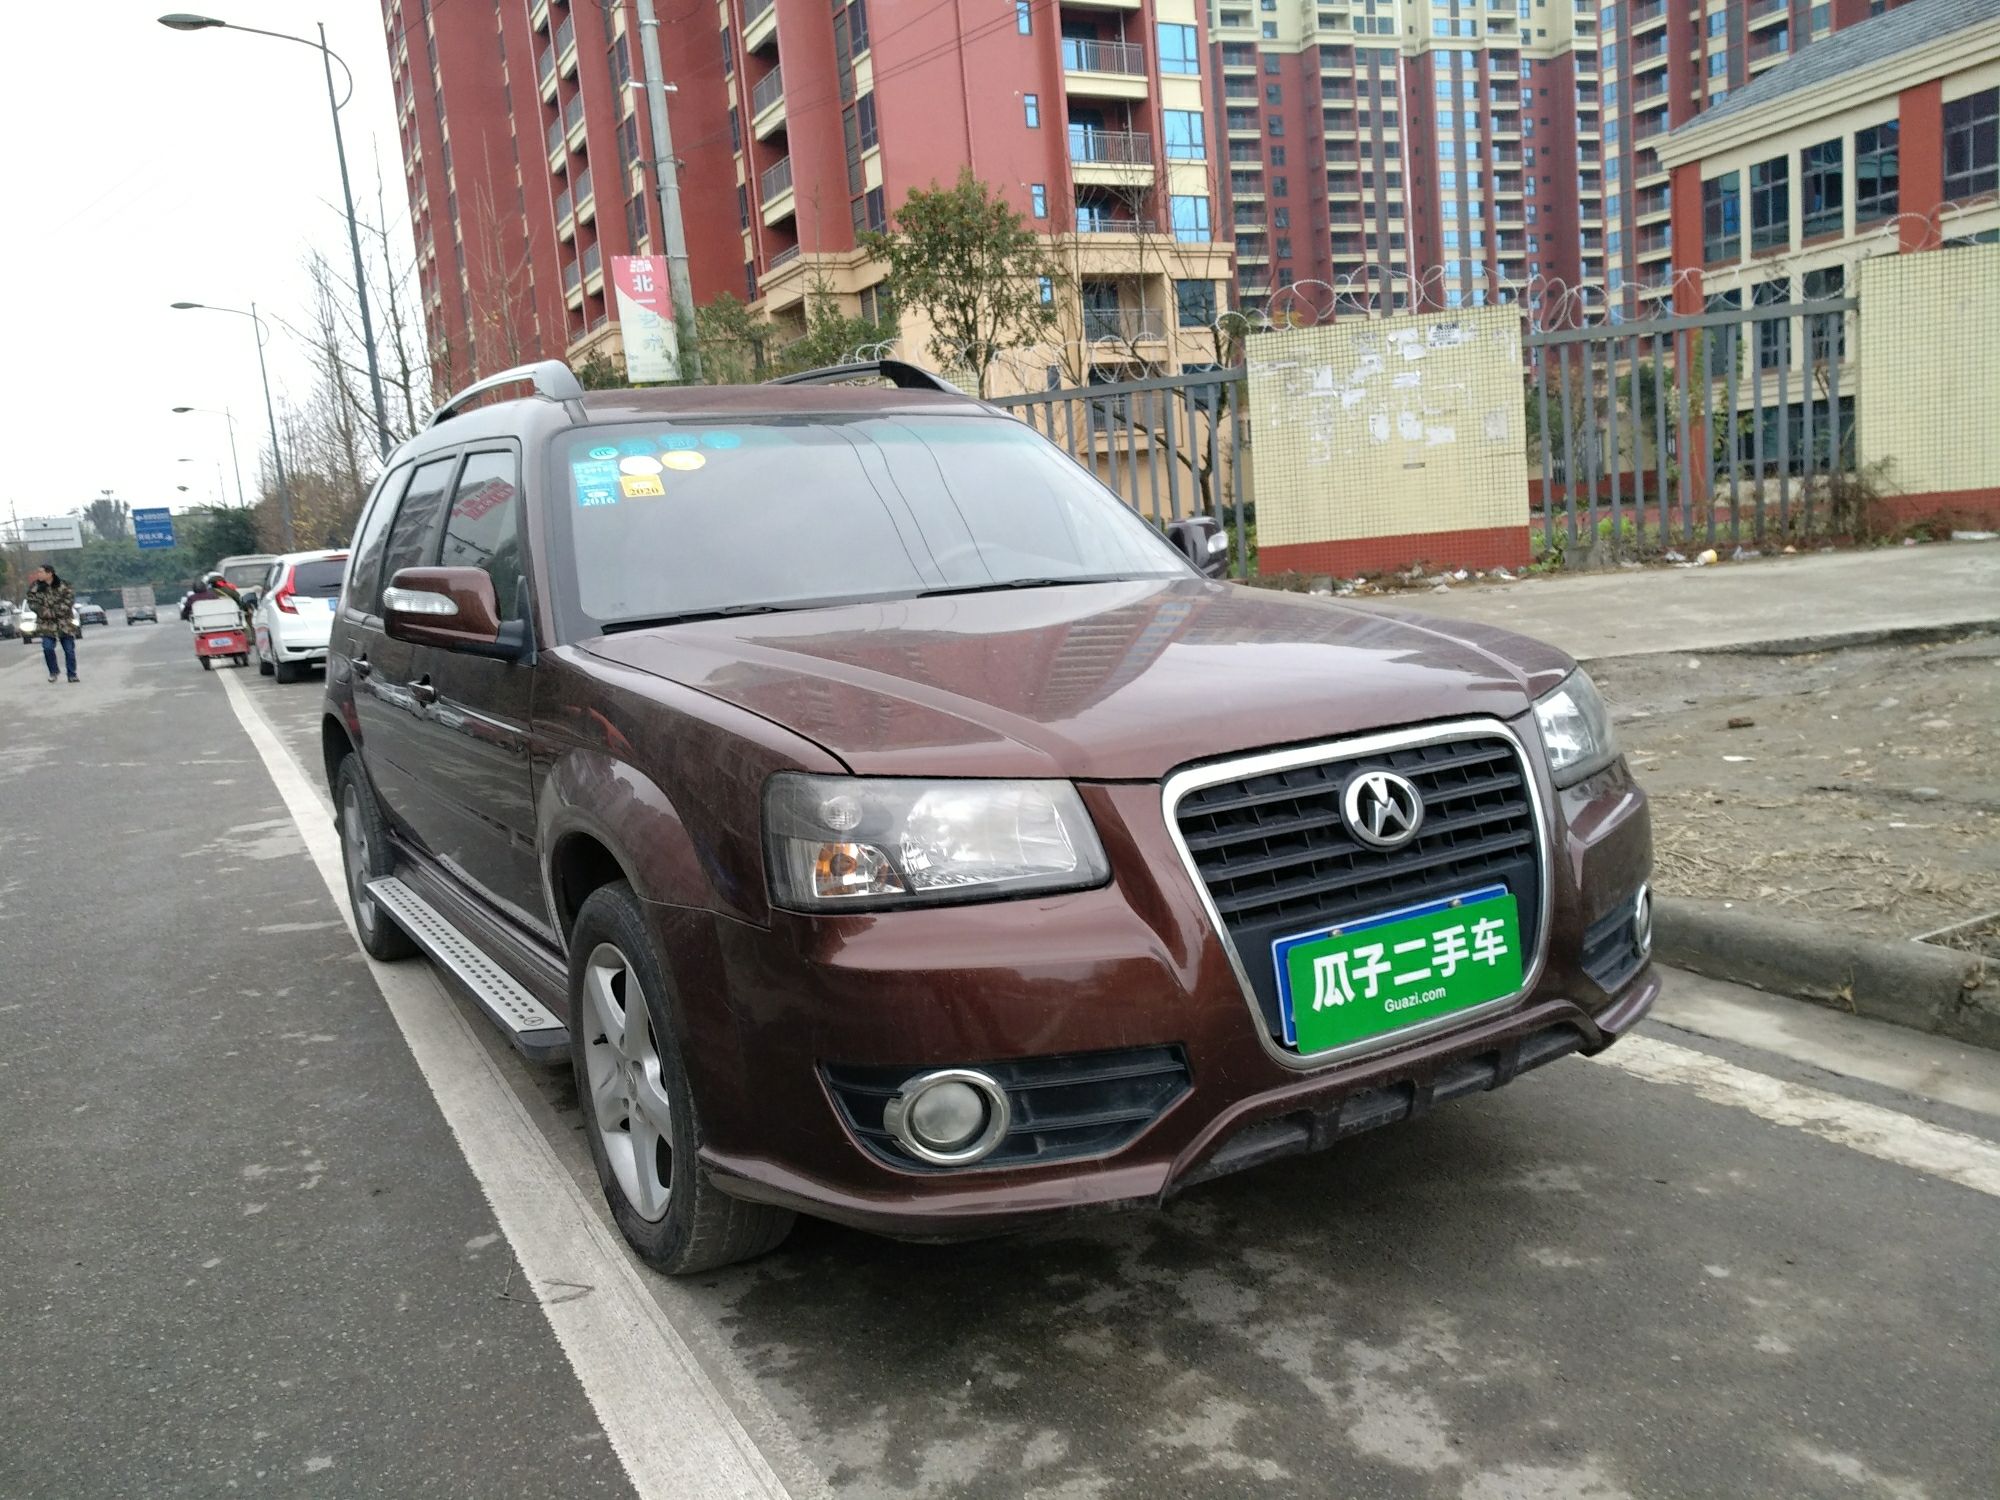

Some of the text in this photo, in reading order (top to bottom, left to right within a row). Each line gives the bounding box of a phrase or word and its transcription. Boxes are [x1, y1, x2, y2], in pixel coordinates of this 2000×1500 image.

[629, 486, 660, 496] 2020
[582, 496, 616, 506] 2016
[1312, 917, 1508, 1012] 瓜子二手车
[1384, 986, 1447, 1013] Guazi.com
